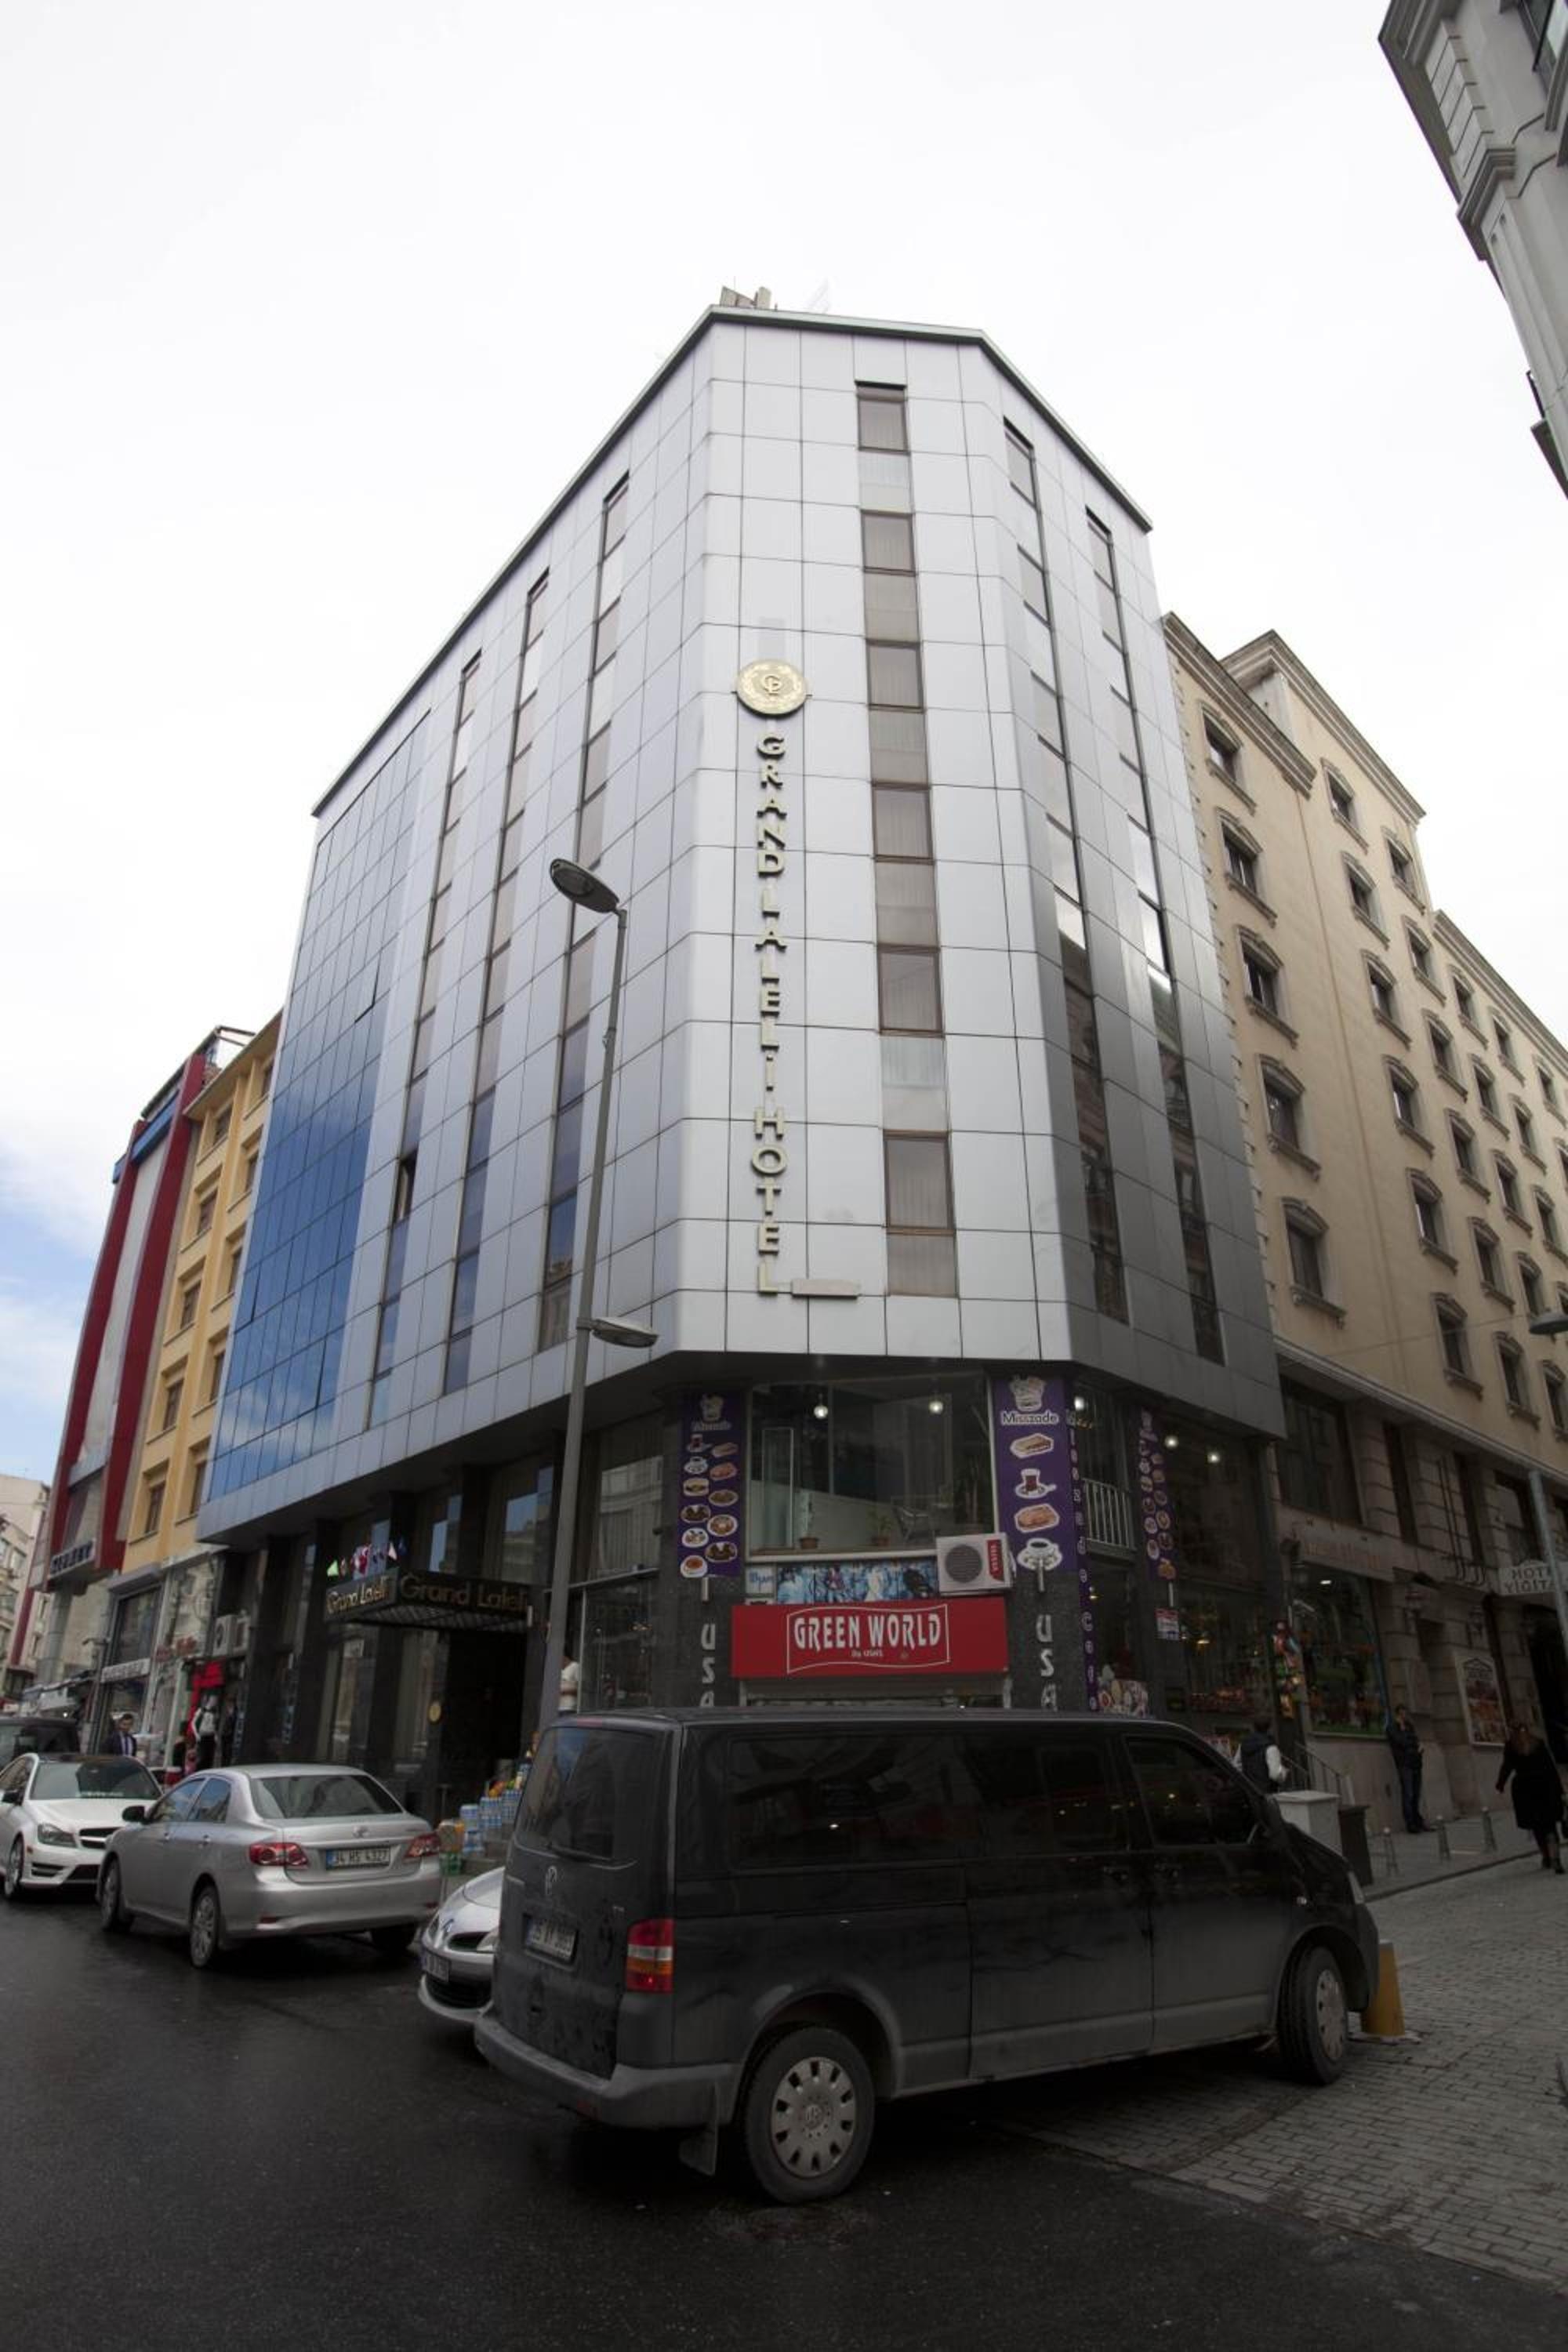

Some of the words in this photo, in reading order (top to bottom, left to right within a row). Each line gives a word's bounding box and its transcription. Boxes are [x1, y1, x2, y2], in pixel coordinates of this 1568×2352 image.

[756, 732, 787, 877] GRAND
[752, 1106, 786, 1297] HOTEL
[401, 1574, 470, 1607] Grand
[477, 1585, 528, 1613] Laleli
[794, 1615, 860, 1652] GREEN
[868, 1613, 941, 1650] WORLD
